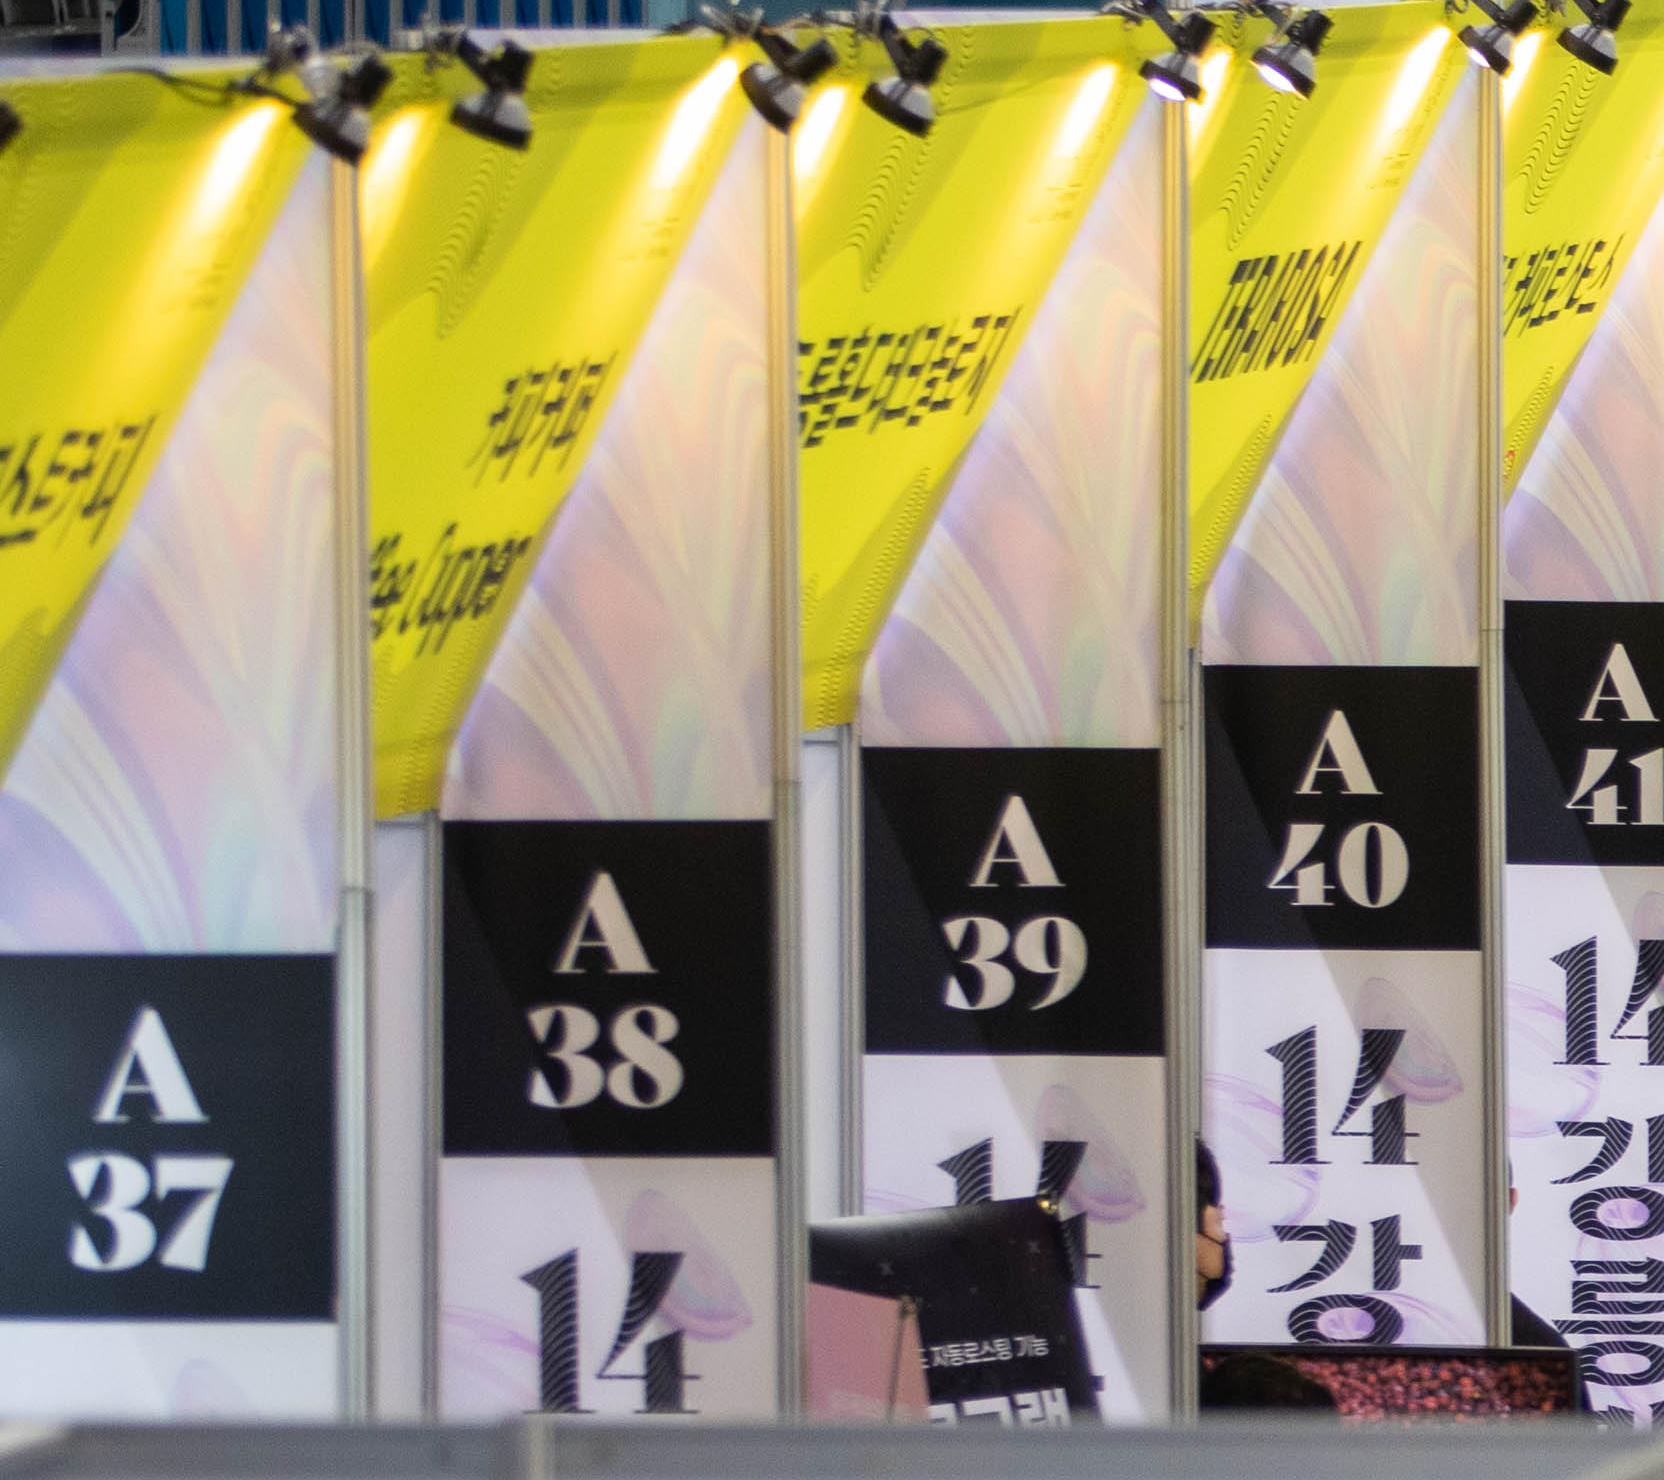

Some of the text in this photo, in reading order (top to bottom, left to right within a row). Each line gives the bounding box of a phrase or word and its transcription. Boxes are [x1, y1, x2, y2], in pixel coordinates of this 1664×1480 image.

[1190, 240, 1362, 383] TERAROSA
[1580, 641, 1661, 724] A
[1294, 708, 1383, 798] A
[966, 794, 1068, 890] A
[1269, 821, 1411, 910] 40
[553, 870, 659, 978] A
[942, 913, 1089, 1013] 39
[94, 1005, 209, 1127] A
[526, 1004, 686, 1112] 38
[1266, 1025, 1422, 1169] 14
[67, 1151, 236, 1276] 37
[518, 1247, 702, 1415] 14
